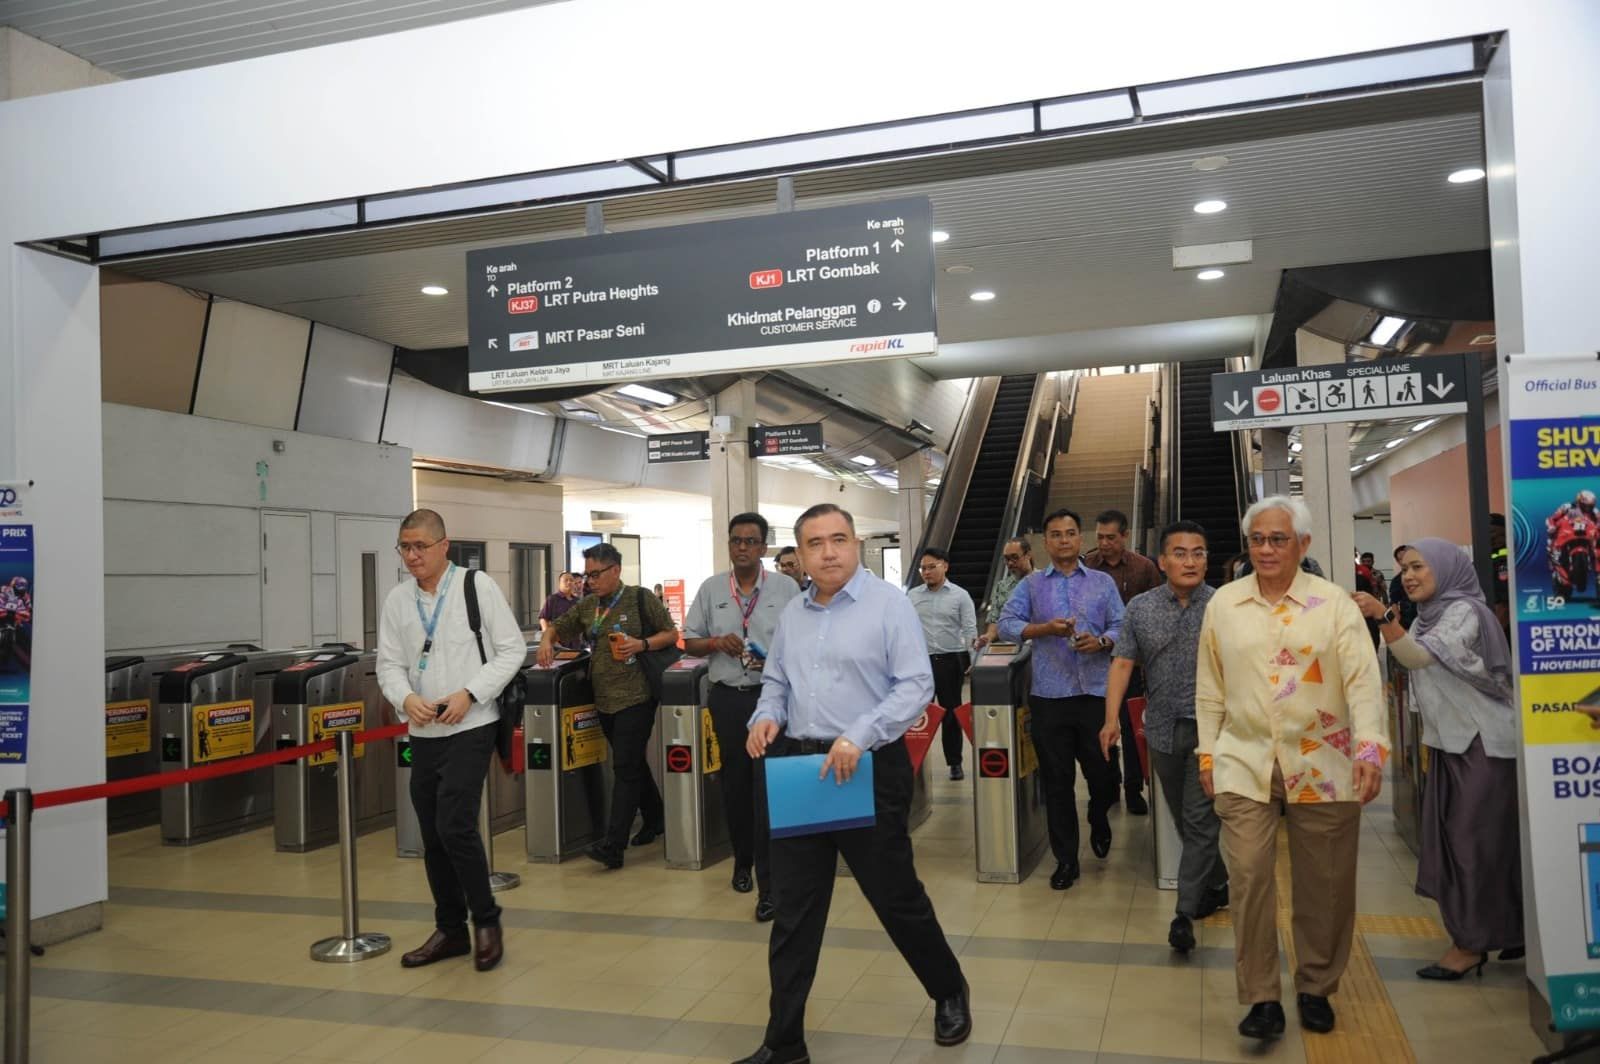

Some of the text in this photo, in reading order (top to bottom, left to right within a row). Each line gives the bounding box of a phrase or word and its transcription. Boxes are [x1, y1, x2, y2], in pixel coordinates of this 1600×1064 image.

[867, 217, 904, 230] Ke arah
[806, 242, 880, 262] Platform 1
[486, 262, 517, 274] Ke arah
[756, 262, 880, 285] KJ1 LRT Gombak
[508, 276, 573, 295] Platform 2
[511, 284, 659, 312] KJ37 LRT Putra Heights
[727, 304, 856, 326] Khidmat Pelanggan
[545, 330, 575, 344] MRT
[577, 326, 612, 341] Pasar
[616, 323, 645, 337] Seni
[760, 318, 856, 335] CUSTOMER SERVICE
[850, 338, 904, 353] rapidKL
[620, 360, 644, 369] Laluan
[646, 358, 670, 367] Kajang
[491, 366, 570, 380] LRT Laluan Kelana Jaya
[1261, 364, 1410, 384] Laluan Khas SPECIAL LANE
[1525, 379, 1597, 392] Official Bus
[1537, 426, 1600, 447] SHUT
[1538, 448, 1600, 469] SERV
[2, 528, 27, 537] PRIX
[1530, 624, 1600, 639] PETRON
[1531, 637, 1600, 652] OF MAL
[1532, 661, 1538, 671] 1
